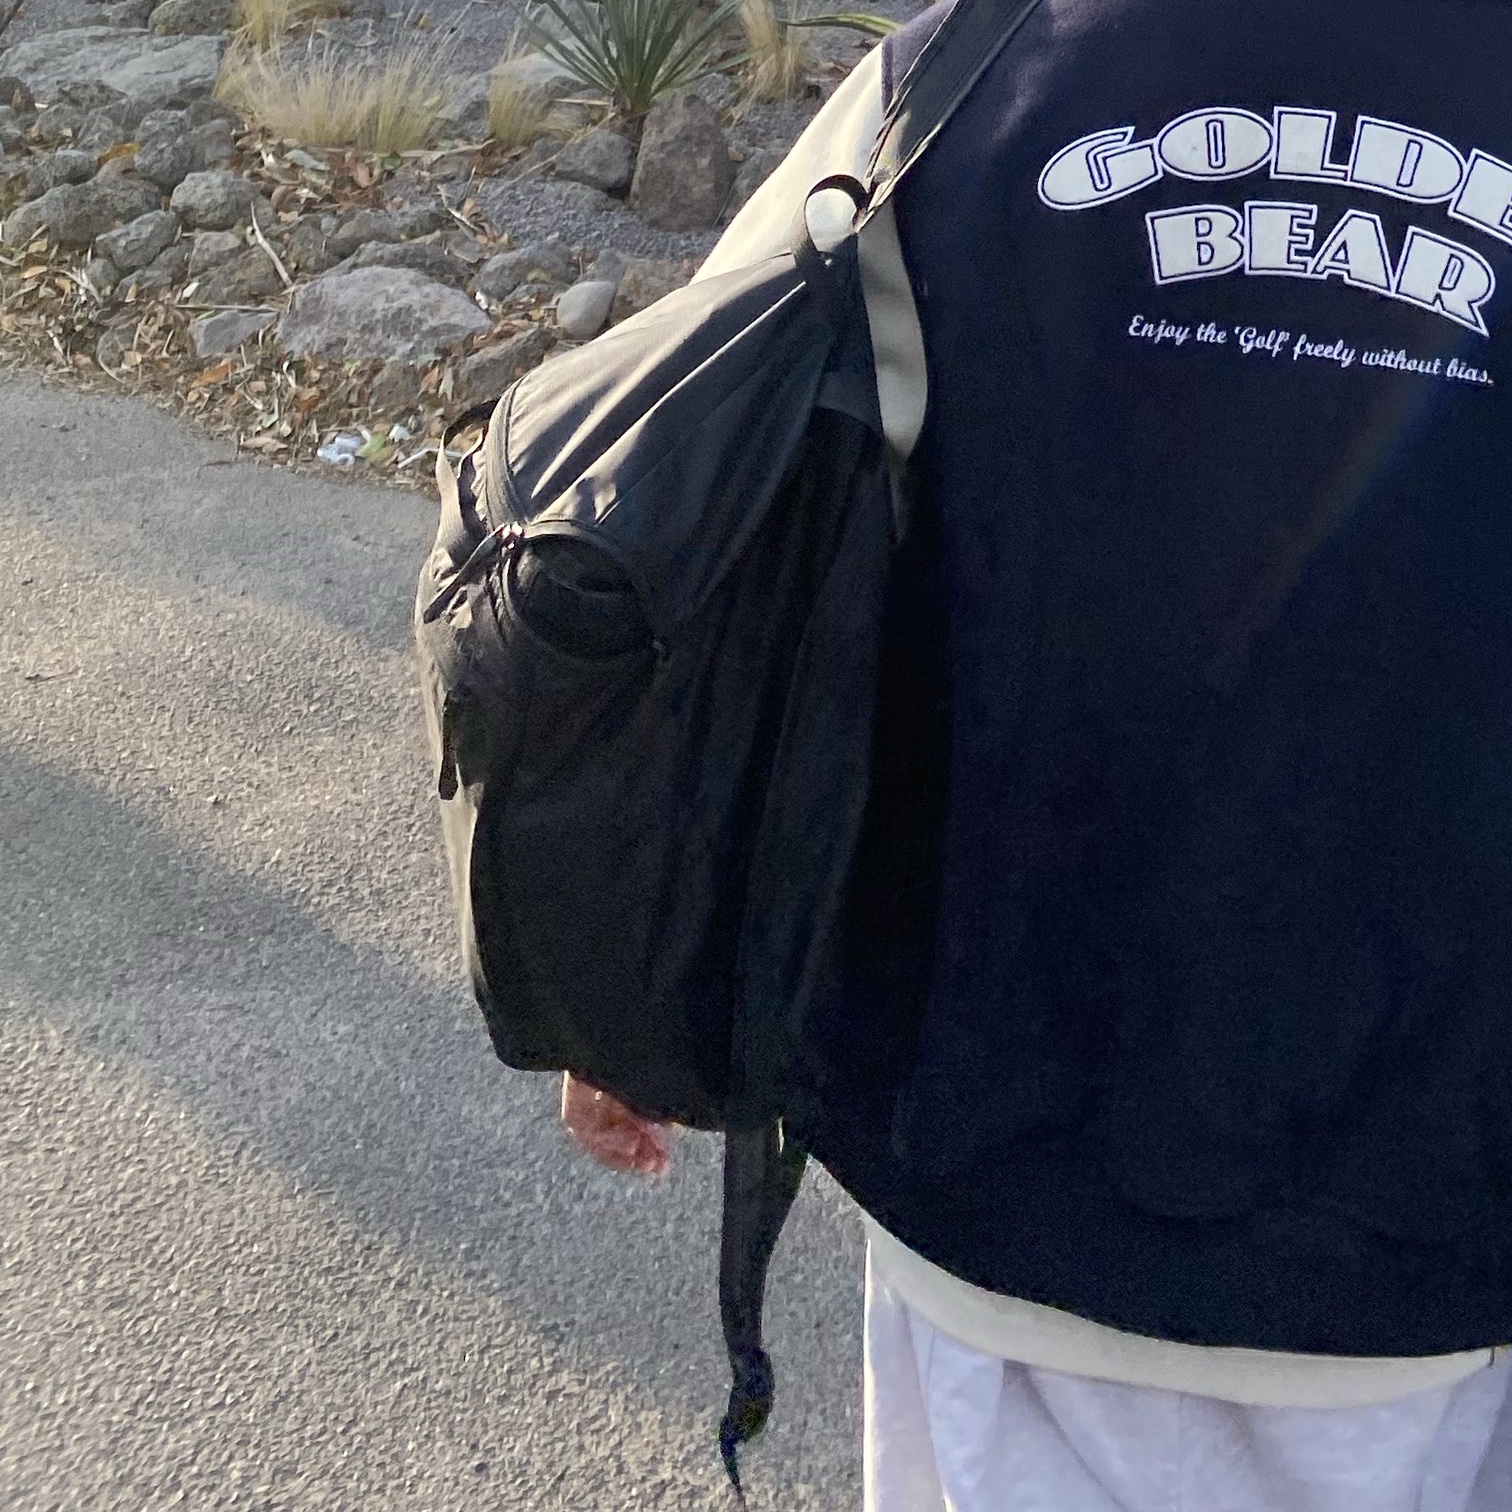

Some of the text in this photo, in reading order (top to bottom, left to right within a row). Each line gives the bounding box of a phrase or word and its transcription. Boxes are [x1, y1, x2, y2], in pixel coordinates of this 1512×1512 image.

[1144, 200, 1496, 337] BEAR
[1128, 314, 1191, 346] Enjoy
[1196, 322, 1228, 344] the
[1292, 333, 1357, 368] freely
[1361, 348, 1442, 376] without
[1446, 357, 1495, 386] bias.
